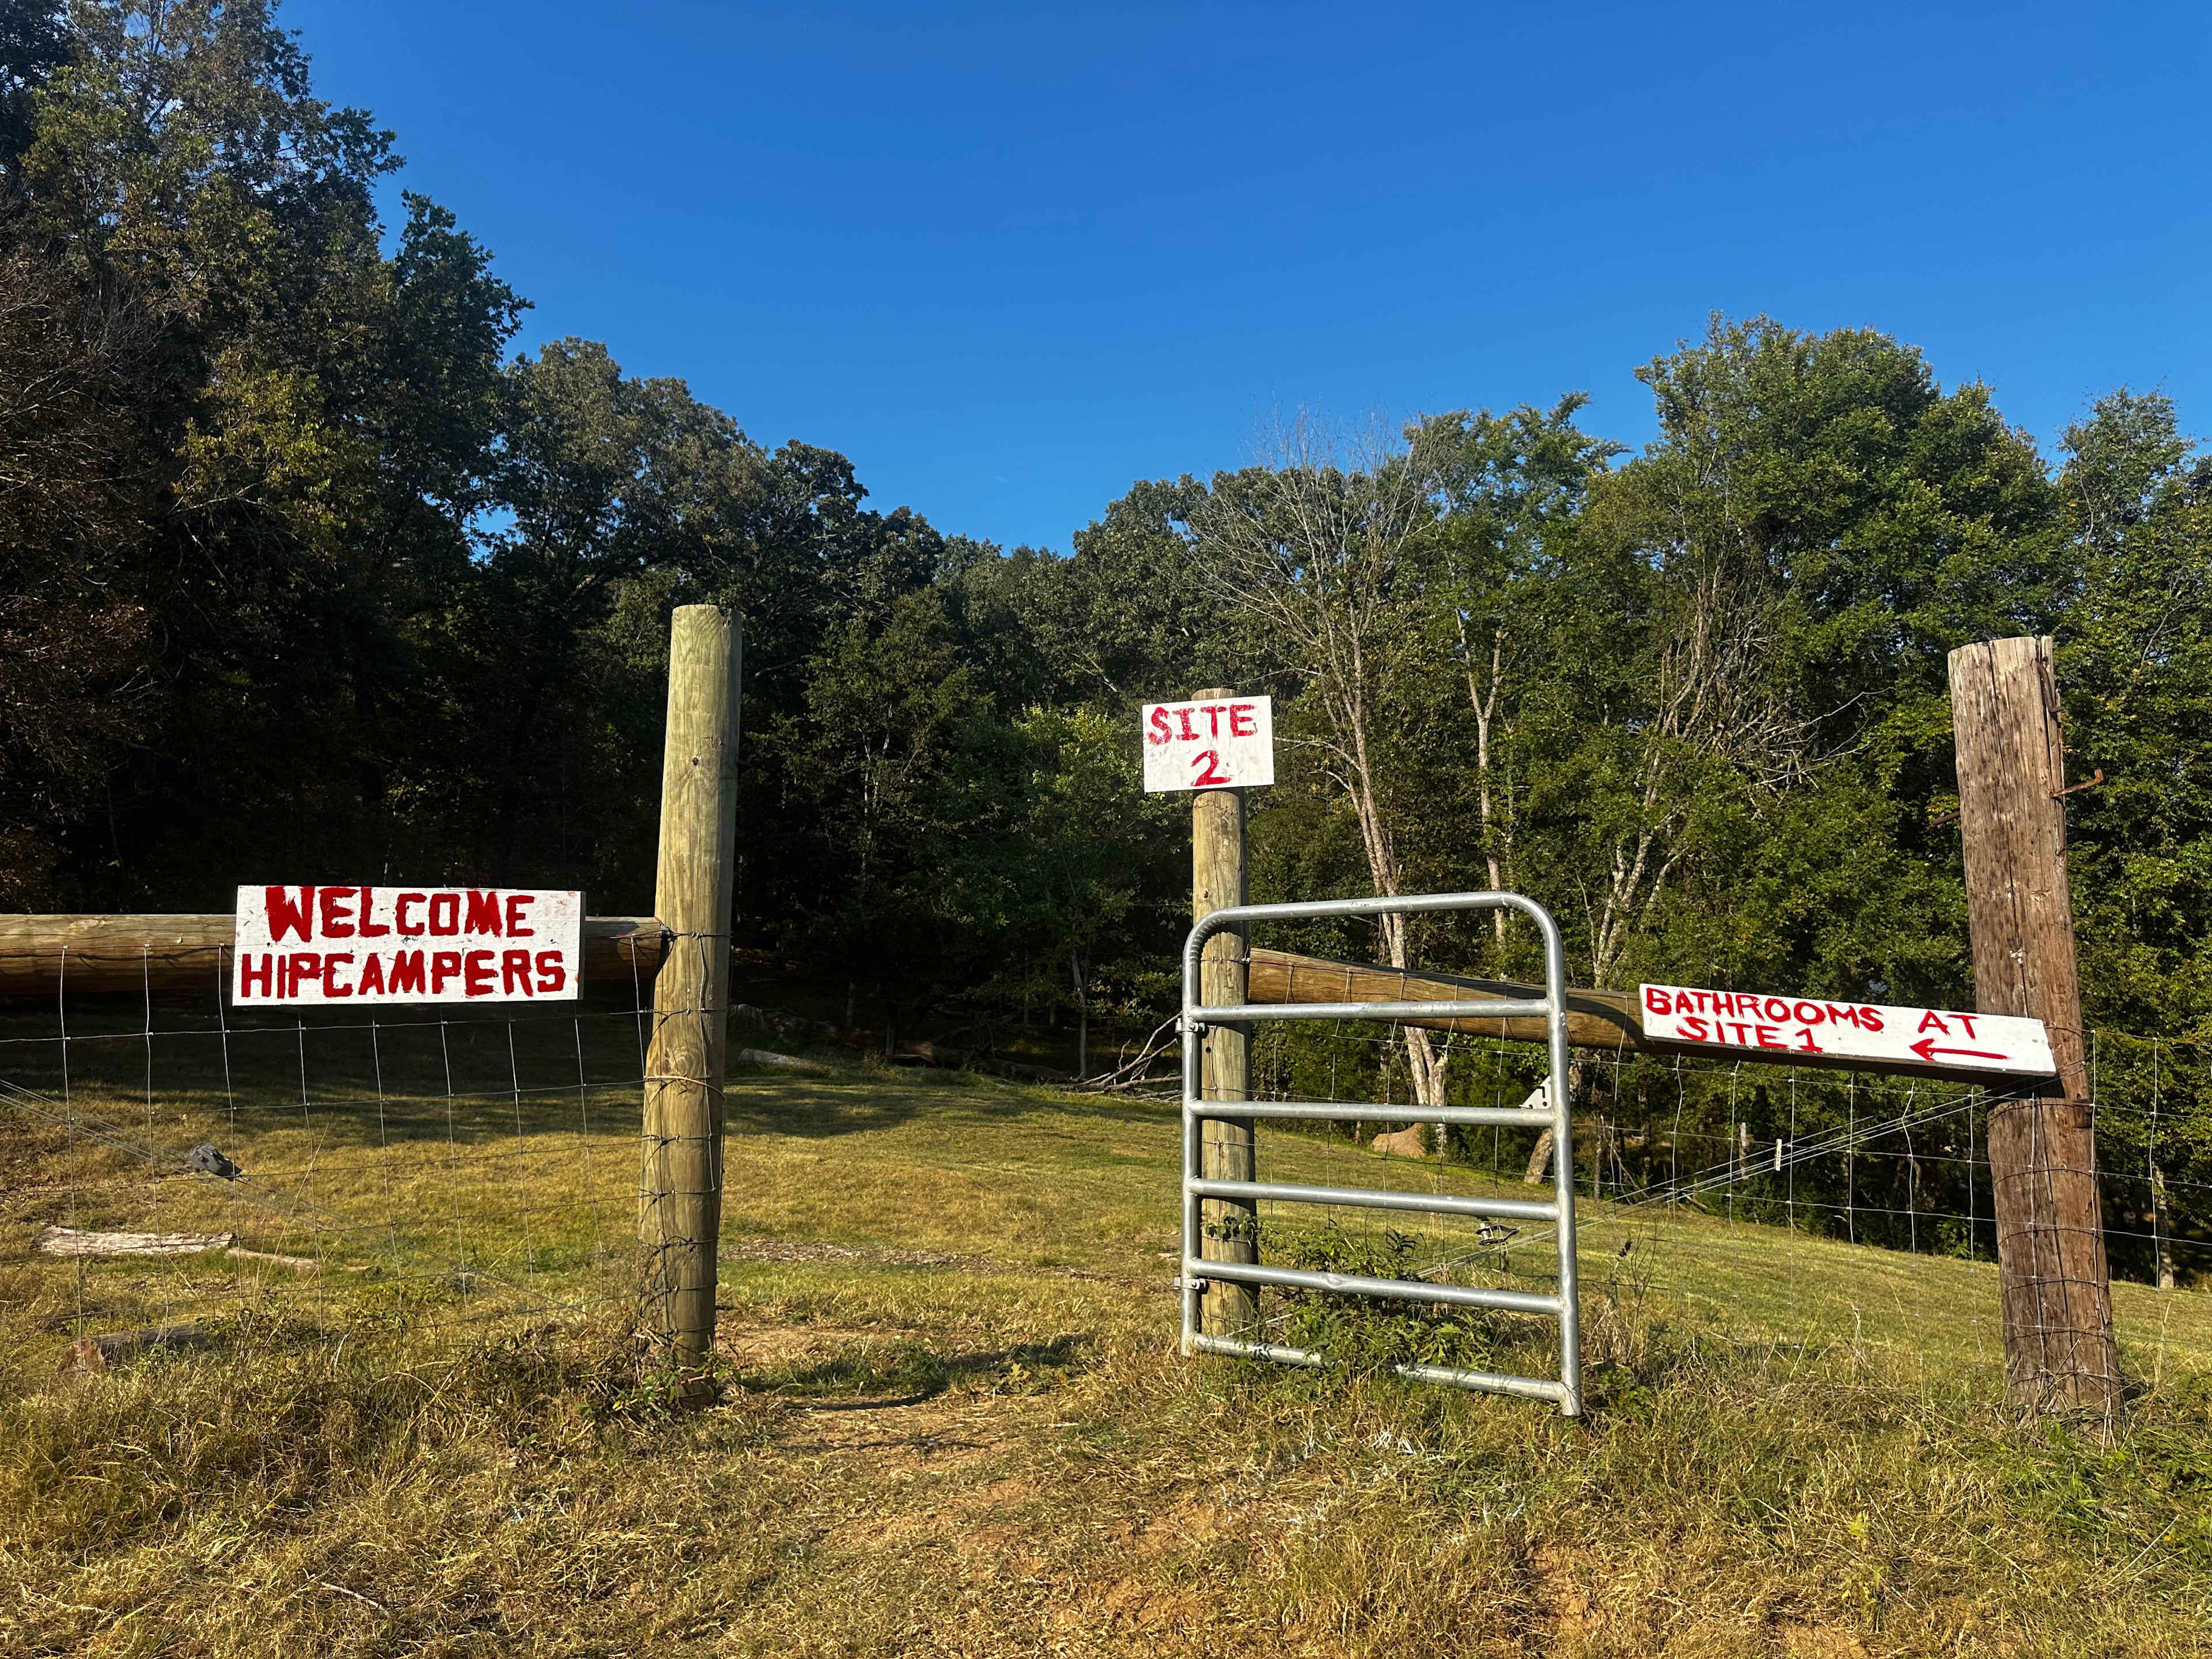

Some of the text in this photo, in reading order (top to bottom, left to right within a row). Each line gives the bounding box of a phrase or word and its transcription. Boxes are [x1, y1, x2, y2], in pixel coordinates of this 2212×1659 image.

[1147, 704, 1257, 746] SITE
[1190, 749, 1232, 787] 2
[264, 885, 535, 943] WELCOME
[241, 949, 566, 999] HIPCAMPERS
[1646, 987, 1979, 1041] BATHROOMS AT
[1676, 1016, 1823, 1054] SITE 1
